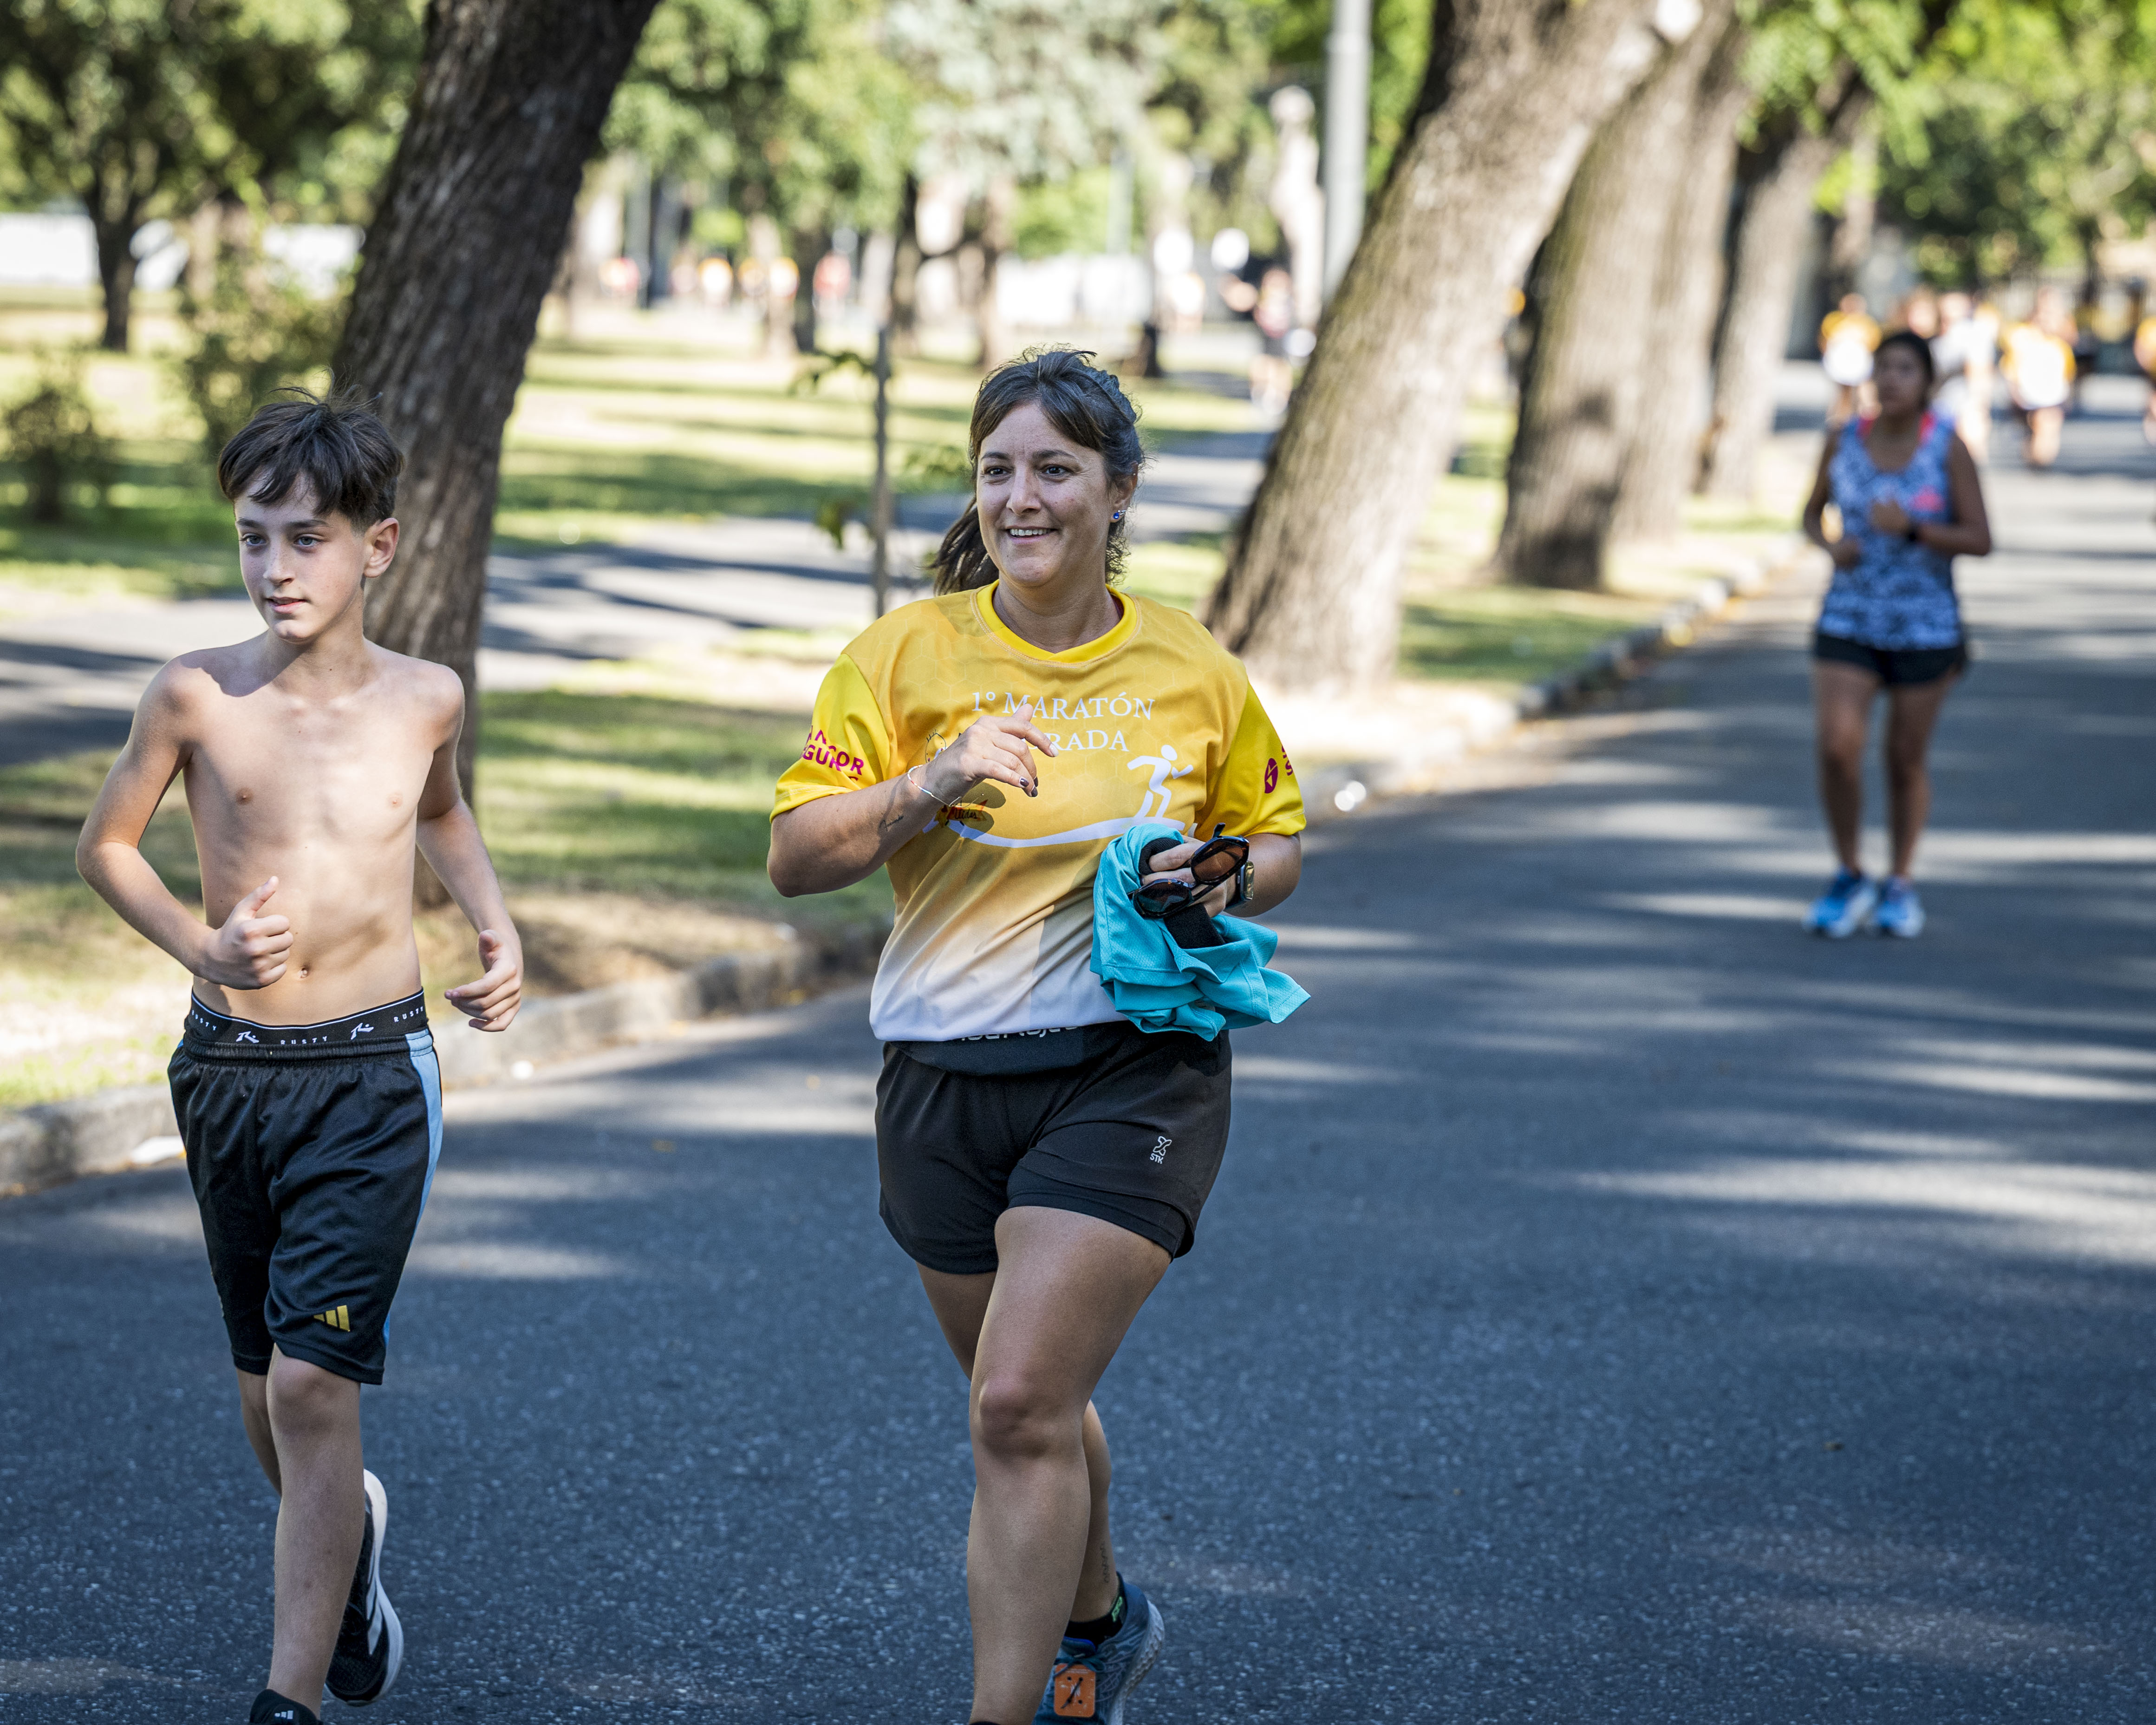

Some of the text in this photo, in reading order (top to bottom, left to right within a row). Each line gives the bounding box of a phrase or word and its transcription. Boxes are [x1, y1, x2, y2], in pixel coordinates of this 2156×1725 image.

[1002, 692, 1155, 720] MARATÓN
[1022, 730, 1129, 752] RADA
[393, 1006, 423, 1023] RUSTY
[280, 1035, 327, 1045] RUSTY
[1150, 1153, 1164, 1164] STK
